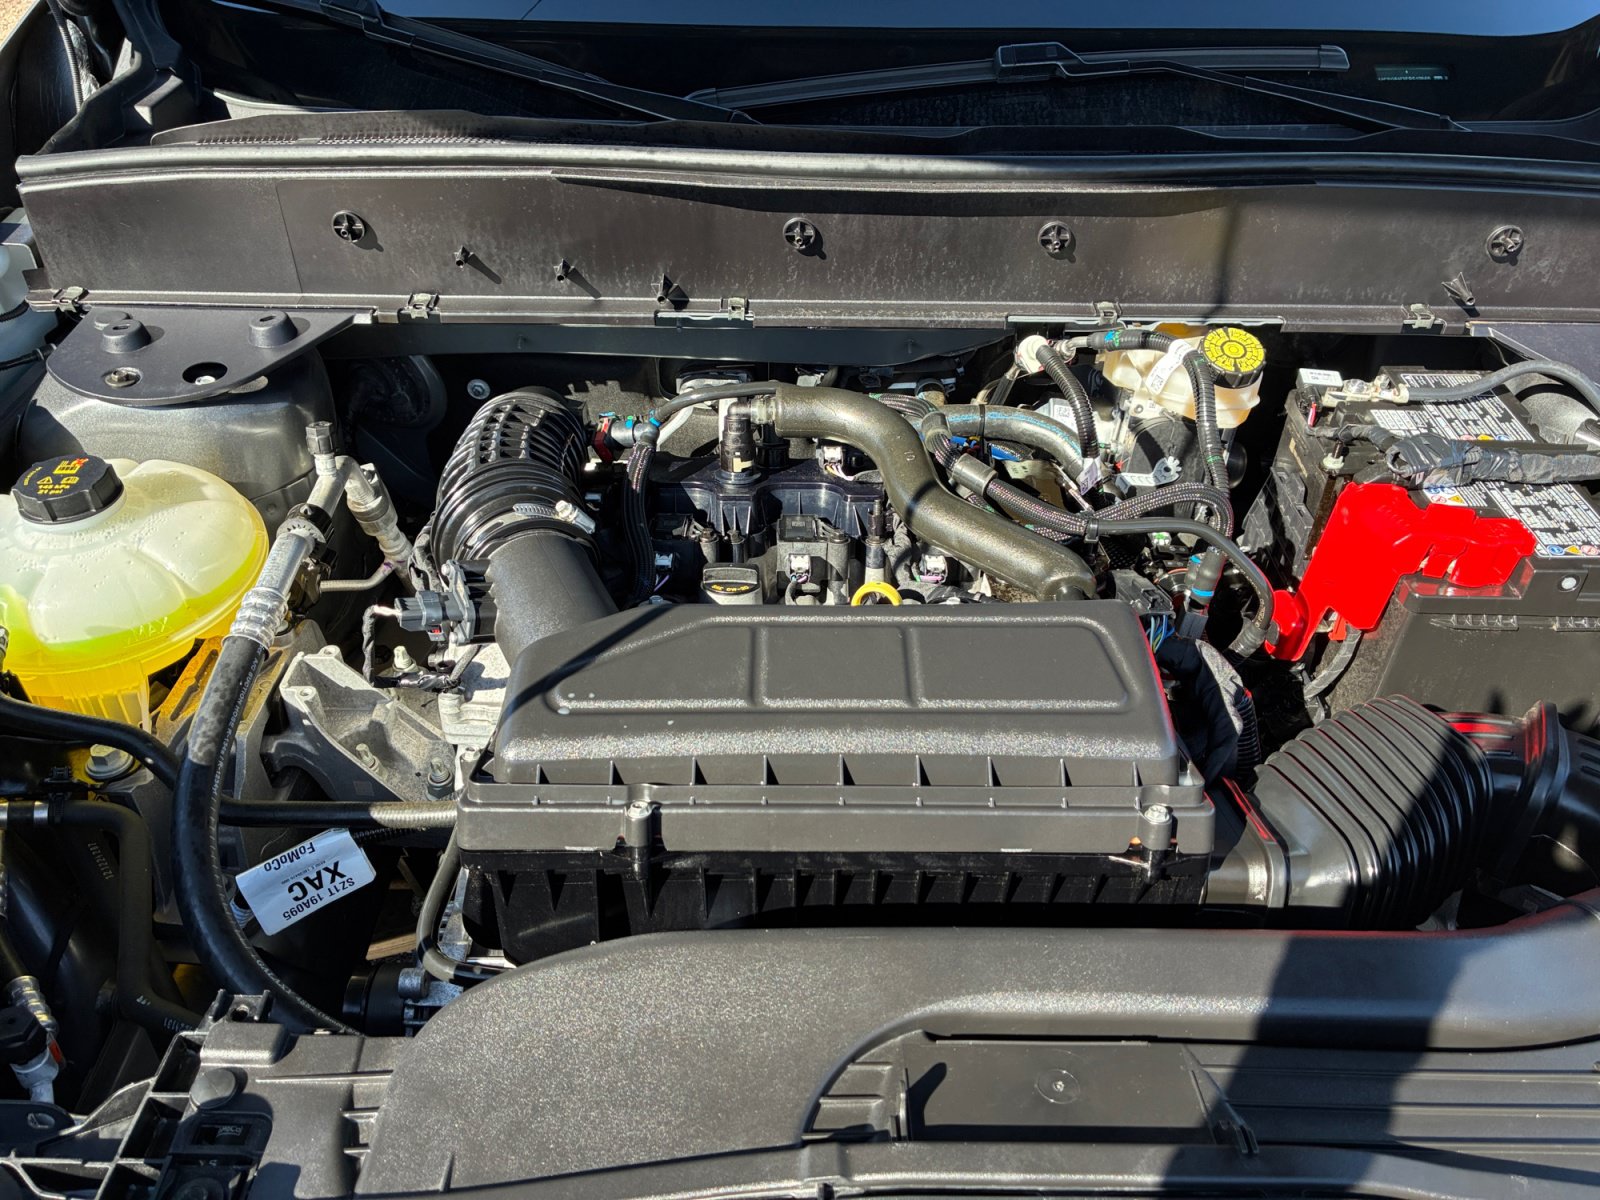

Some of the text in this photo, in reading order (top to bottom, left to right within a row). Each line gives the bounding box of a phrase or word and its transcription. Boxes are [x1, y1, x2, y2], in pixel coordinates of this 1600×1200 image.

[237, 672, 254, 705] SUCTION
[228, 705, 240, 728] HOSE
[263, 842, 316, 872] FoMoCo
[287, 860, 346, 902] XAC
[282, 893, 324, 921] 19A095
